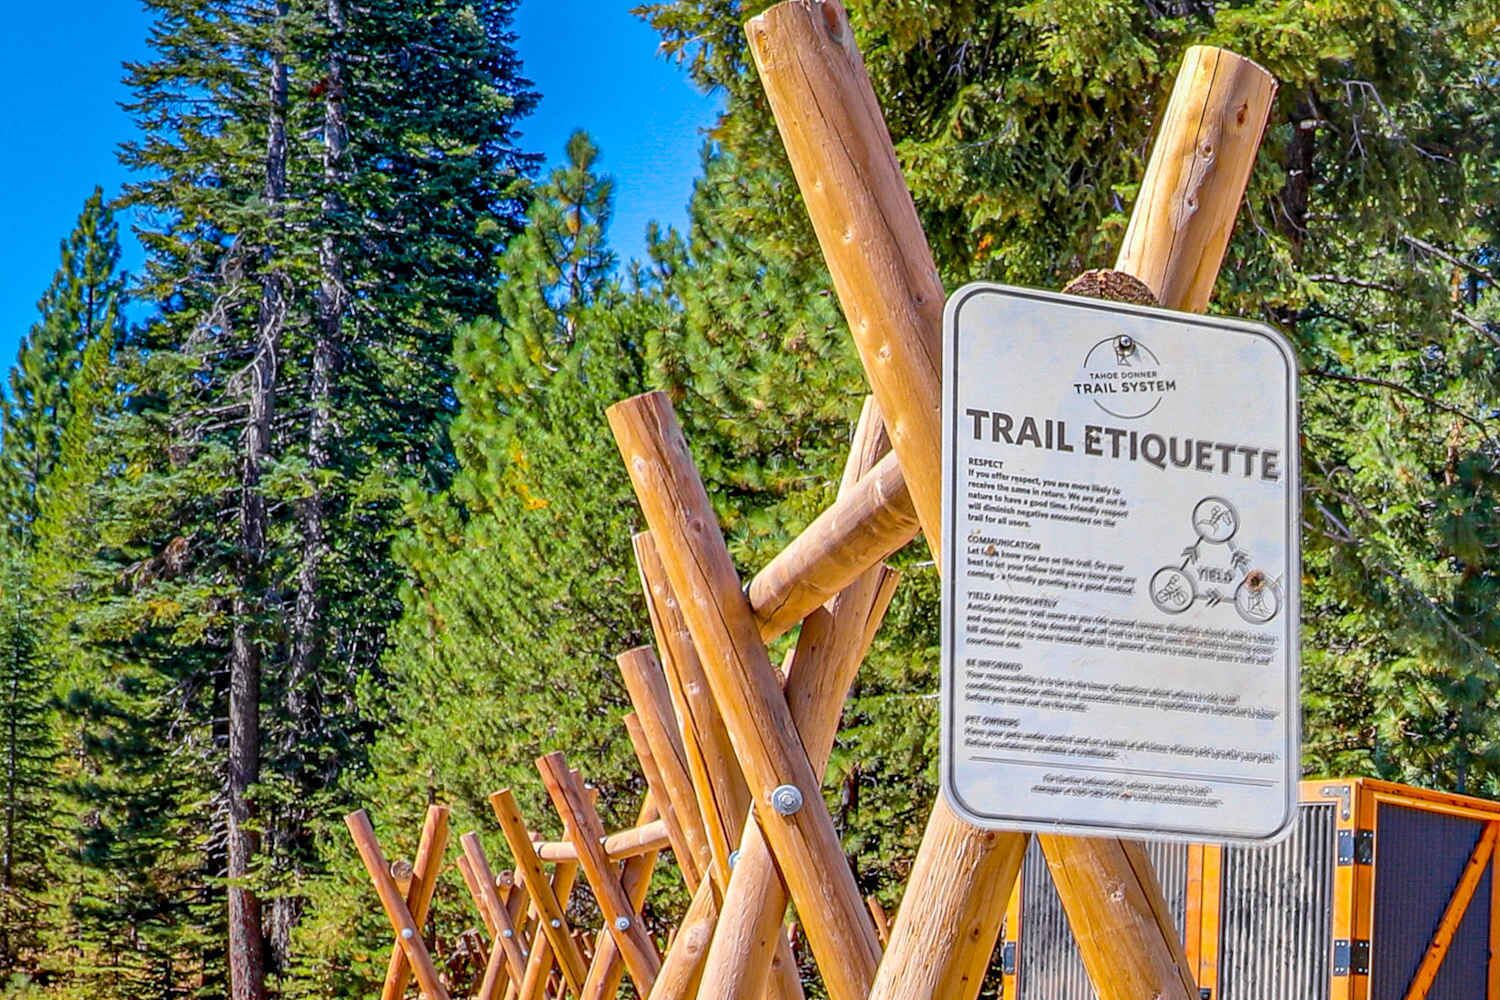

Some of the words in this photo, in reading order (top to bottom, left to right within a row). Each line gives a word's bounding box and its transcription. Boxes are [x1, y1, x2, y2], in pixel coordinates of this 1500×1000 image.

[1089, 371, 1118, 380] TAHOE
[1121, 370, 1158, 379] DONNER
[1073, 383, 1118, 395] TRAIL
[1121, 380, 1177, 394] SYSTEM
[966, 408, 1074, 453] TRAIL
[1084, 424, 1280, 481] ETIQUETTE
[968, 457, 1003, 468] RESPECT
[975, 472, 989, 480] you
[991, 472, 1008, 481] offer
[1042, 480, 1055, 488] you
[985, 515, 995, 523] for
[967, 535, 1040, 550] COMMUNICATION
[1197, 566, 1235, 584] YIELD
